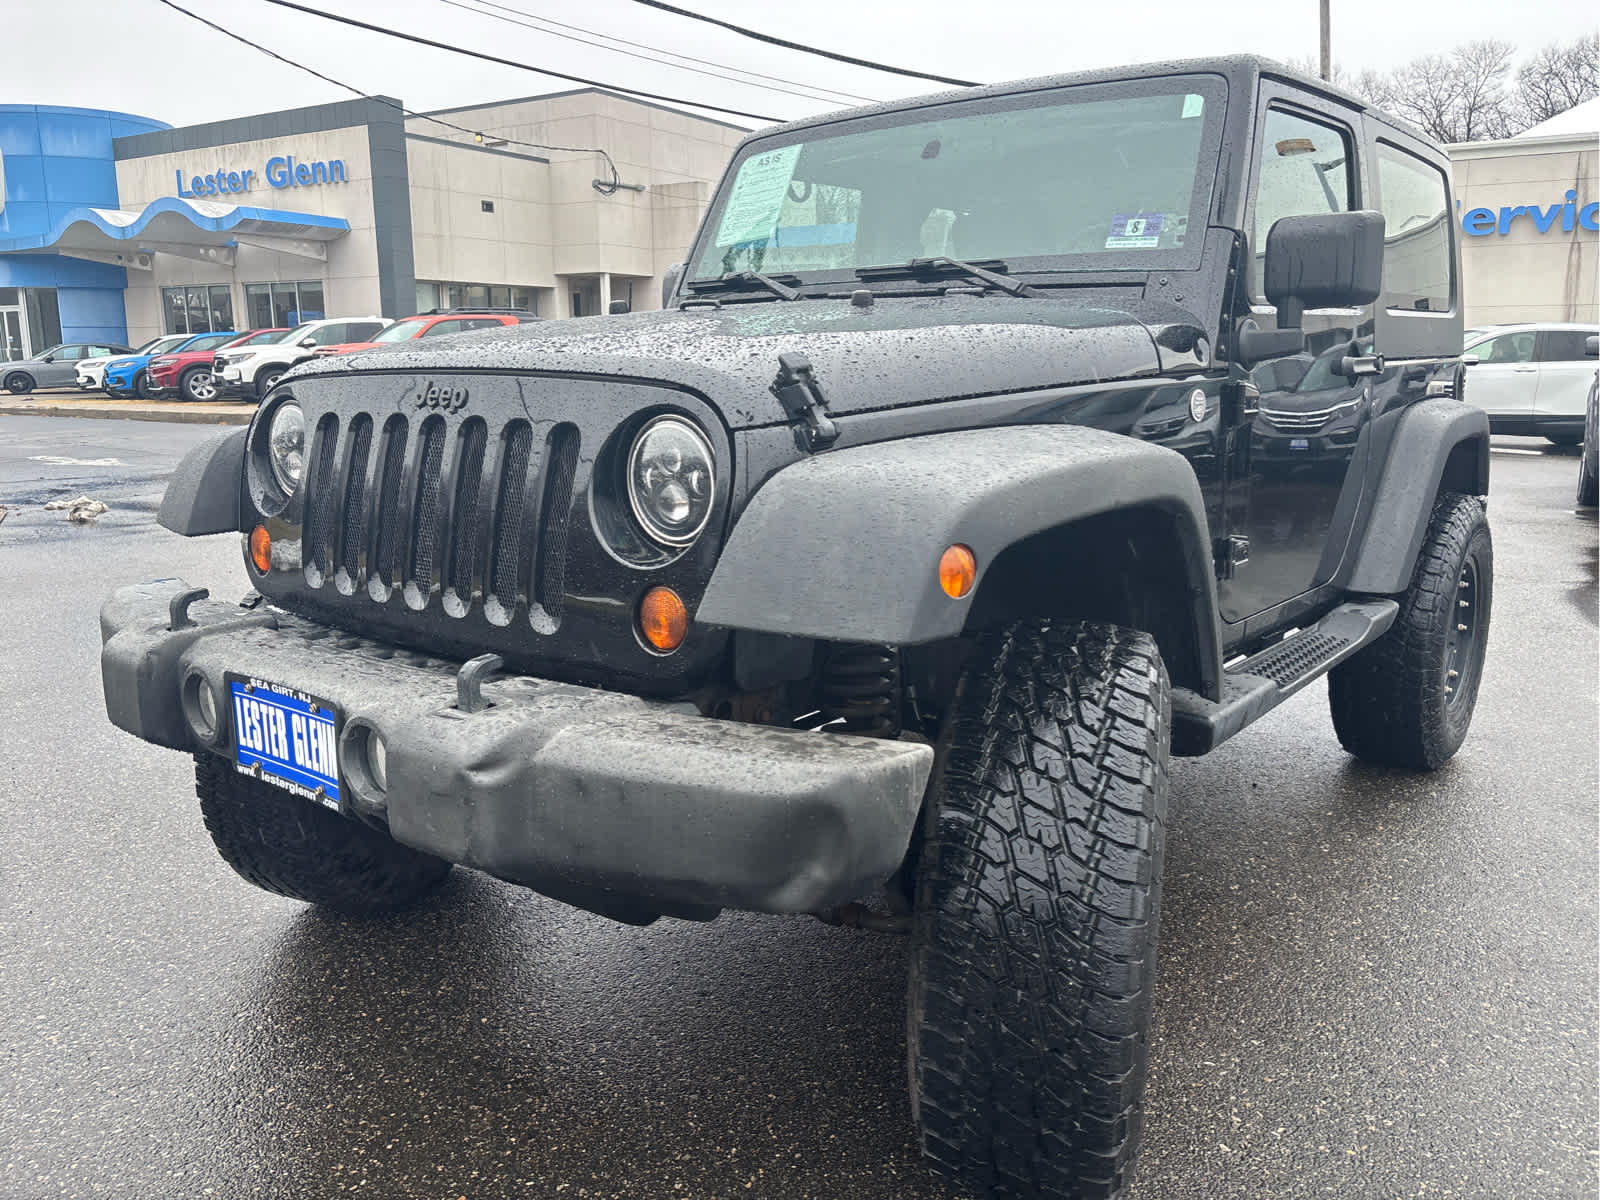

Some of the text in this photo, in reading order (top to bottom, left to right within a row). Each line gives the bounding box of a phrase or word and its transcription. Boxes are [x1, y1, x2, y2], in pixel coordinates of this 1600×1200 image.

[757, 153, 783, 167] AS IS
[175, 155, 346, 198] Lester Glenn
[1131, 220, 1141, 234] 8
[1456, 189, 1600, 236] ervic
[416, 381, 469, 415] Jeep
[249, 678, 271, 691] SEA
[298, 692, 312, 704] NJ
[235, 696, 339, 781] LESTER GLENN
[261, 770, 317, 801] lesterglenn
